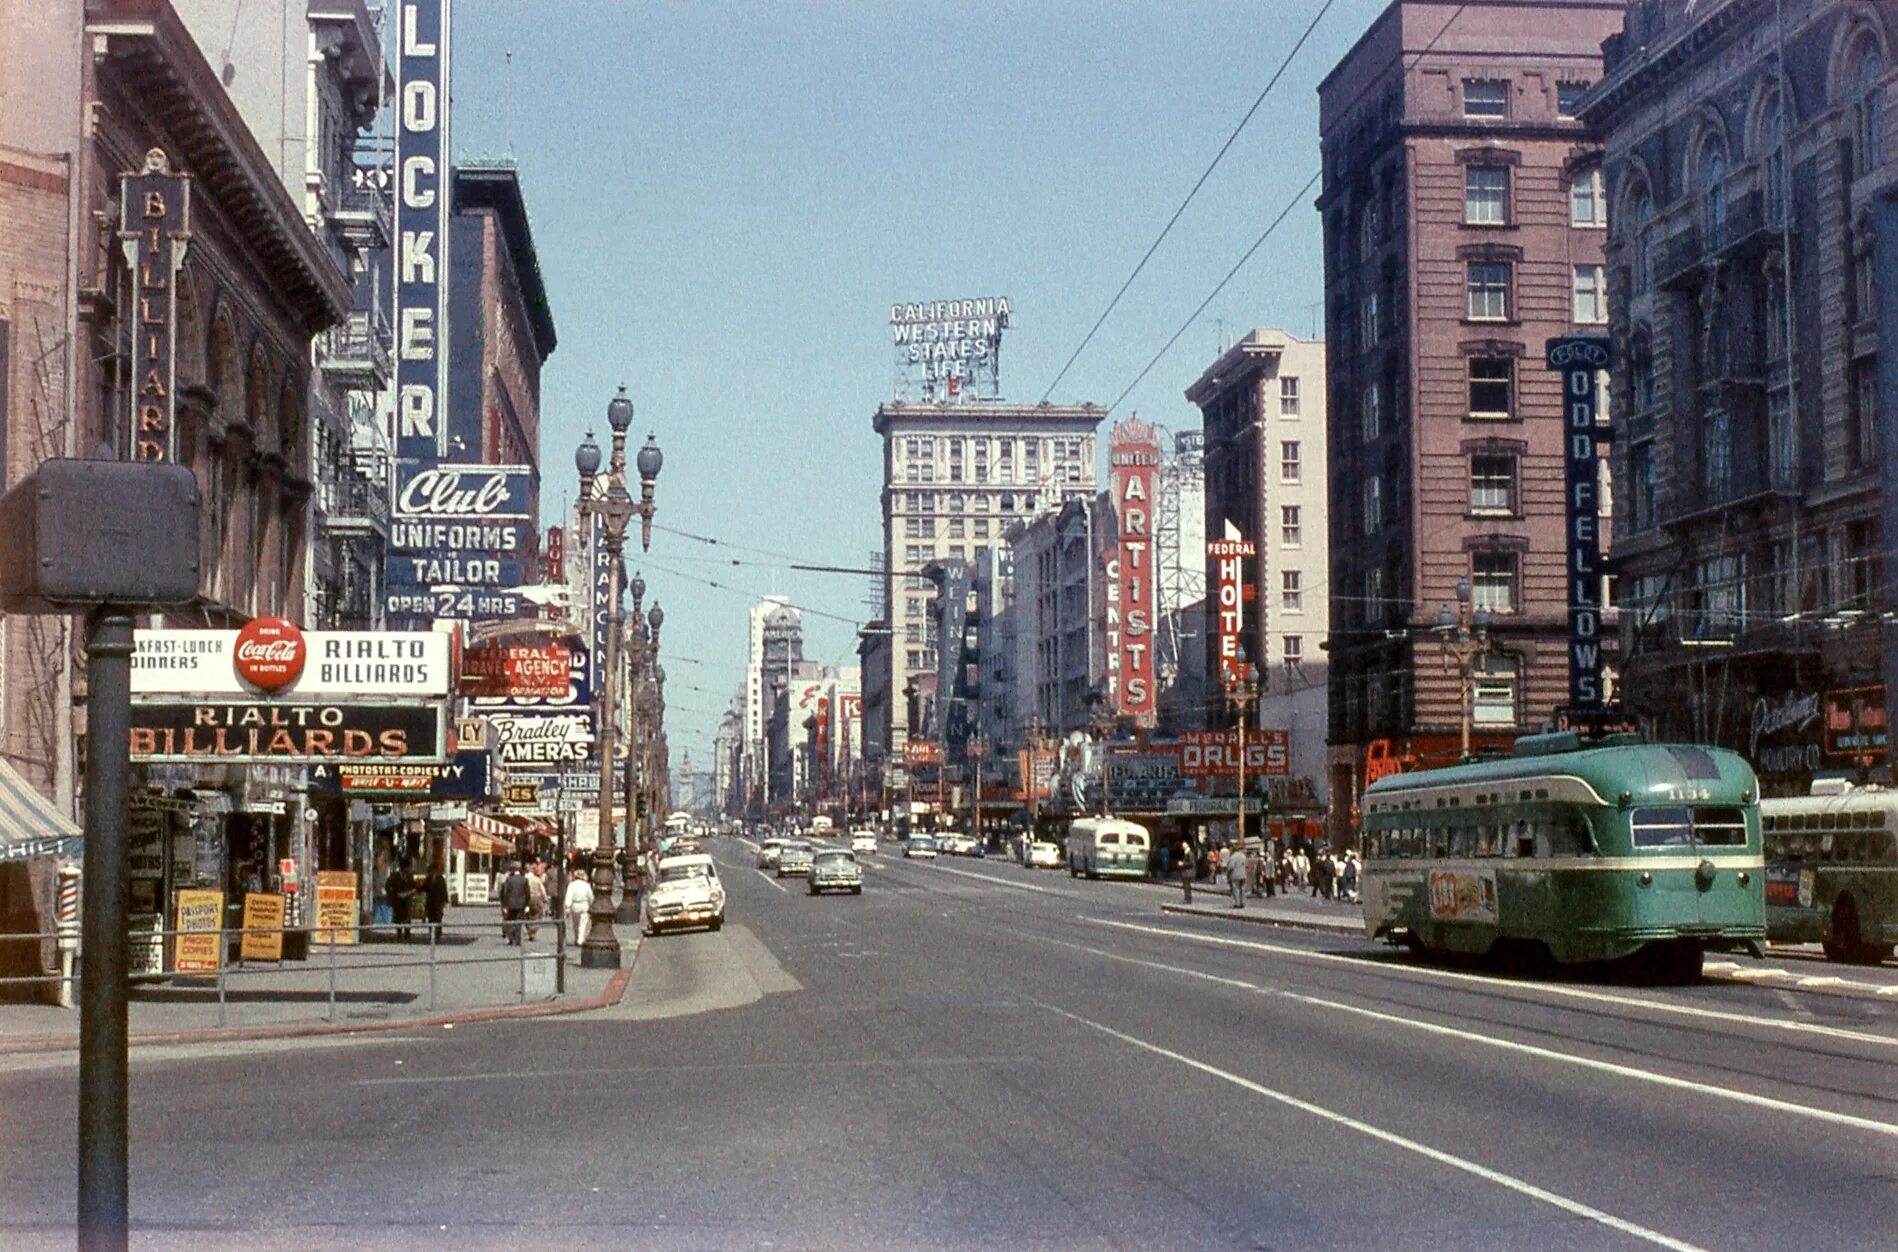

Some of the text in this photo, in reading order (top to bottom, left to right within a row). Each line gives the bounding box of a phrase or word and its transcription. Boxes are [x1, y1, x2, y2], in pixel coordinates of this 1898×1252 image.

[401, 4, 437, 437] LOCKER
[891, 297, 1009, 321] CALIFORNIA
[894, 318, 996, 341] WESTERN
[908, 338, 986, 361] STATES
[921, 359, 968, 378] LIFE
[1112, 452, 1158, 466] UNITED
[399, 470, 511, 513] Club
[391, 525, 516, 550] UNIFORMS
[1571, 371, 1597, 701] ODD FELLOWS
[1208, 543, 1256, 555] FEDERAL
[412, 559, 500, 583] TAILOR
[1125, 474, 1147, 705] ARTISTS
[388, 592, 516, 617] OPEN 24 HRS
[325, 639, 425, 659] RIALTO
[320, 664, 428, 684] BILLIARDS
[514, 660, 569, 676] AGENCY
[194, 706, 344, 727] RIALTO
[130, 726, 408, 756] BILLIARDS
[498, 720, 570, 744] Bradley
[1187, 732, 1283, 745] MERRLL'S
[1183, 745, 1287, 767] DRUGS
